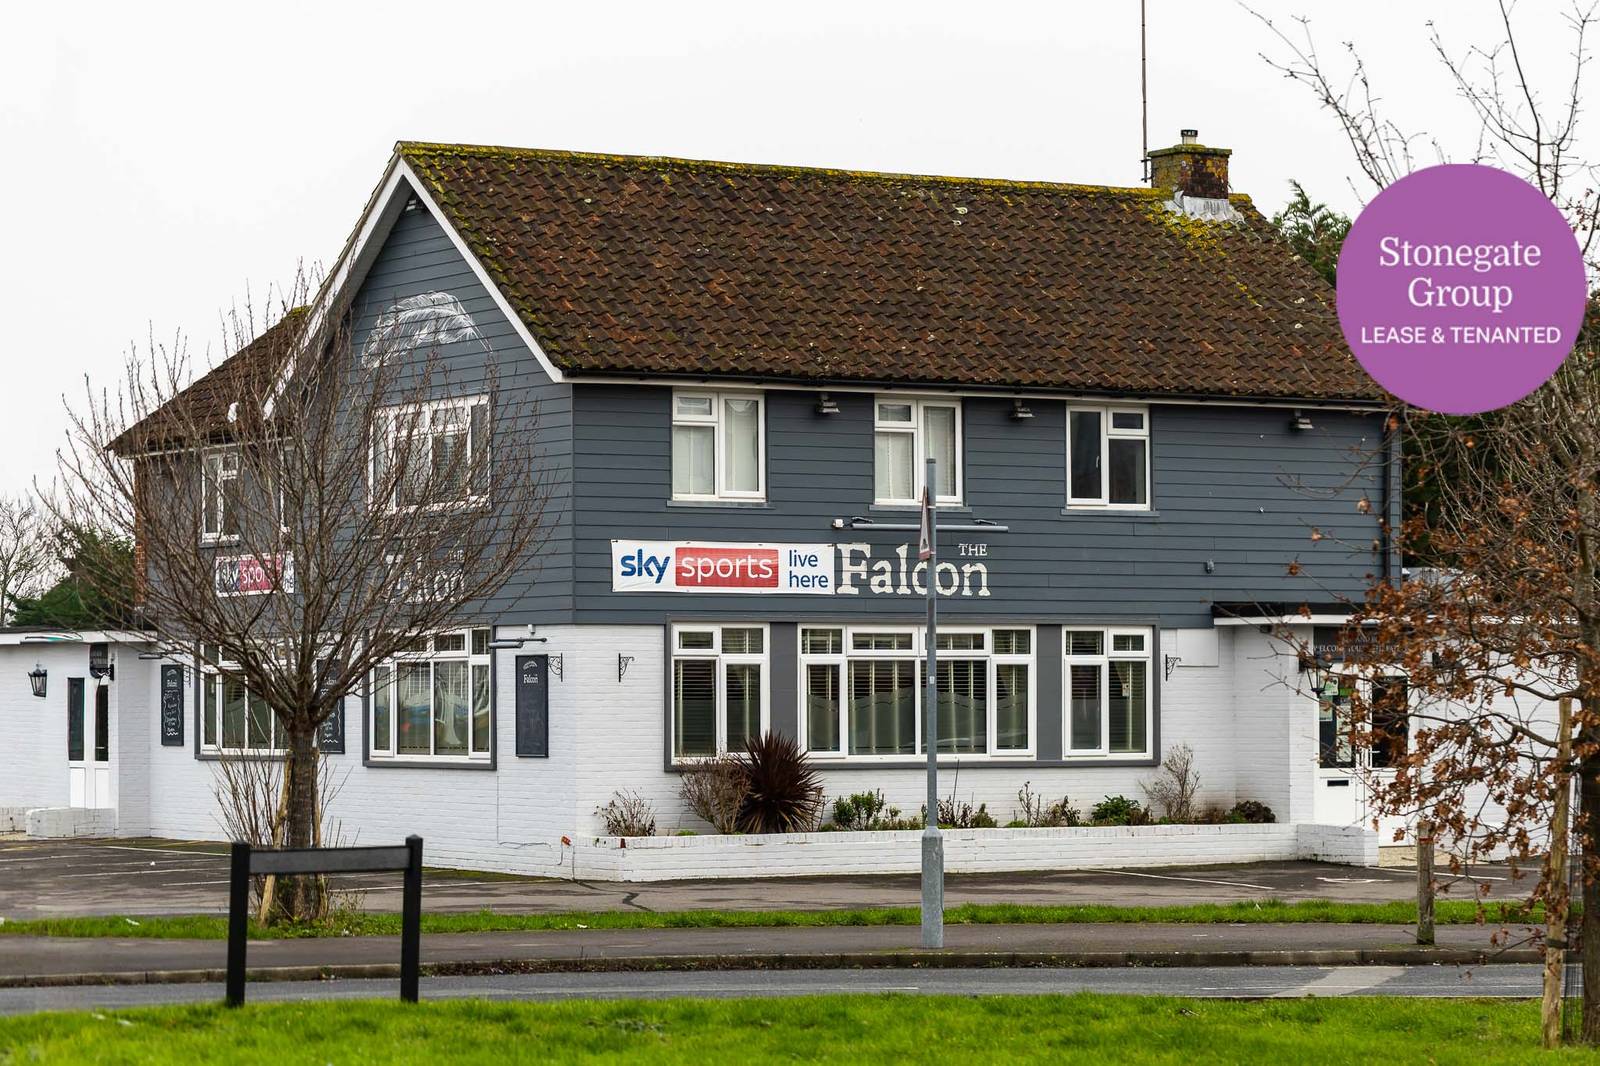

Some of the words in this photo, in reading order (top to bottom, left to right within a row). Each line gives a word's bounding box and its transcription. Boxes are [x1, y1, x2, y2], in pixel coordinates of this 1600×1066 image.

[788, 549, 818, 568] live
[958, 543, 988, 557] THE
[620, 548, 671, 584] sky
[681, 554, 774, 583] sports
[836, 543, 991, 597] Falcon
[788, 570, 829, 588] here
